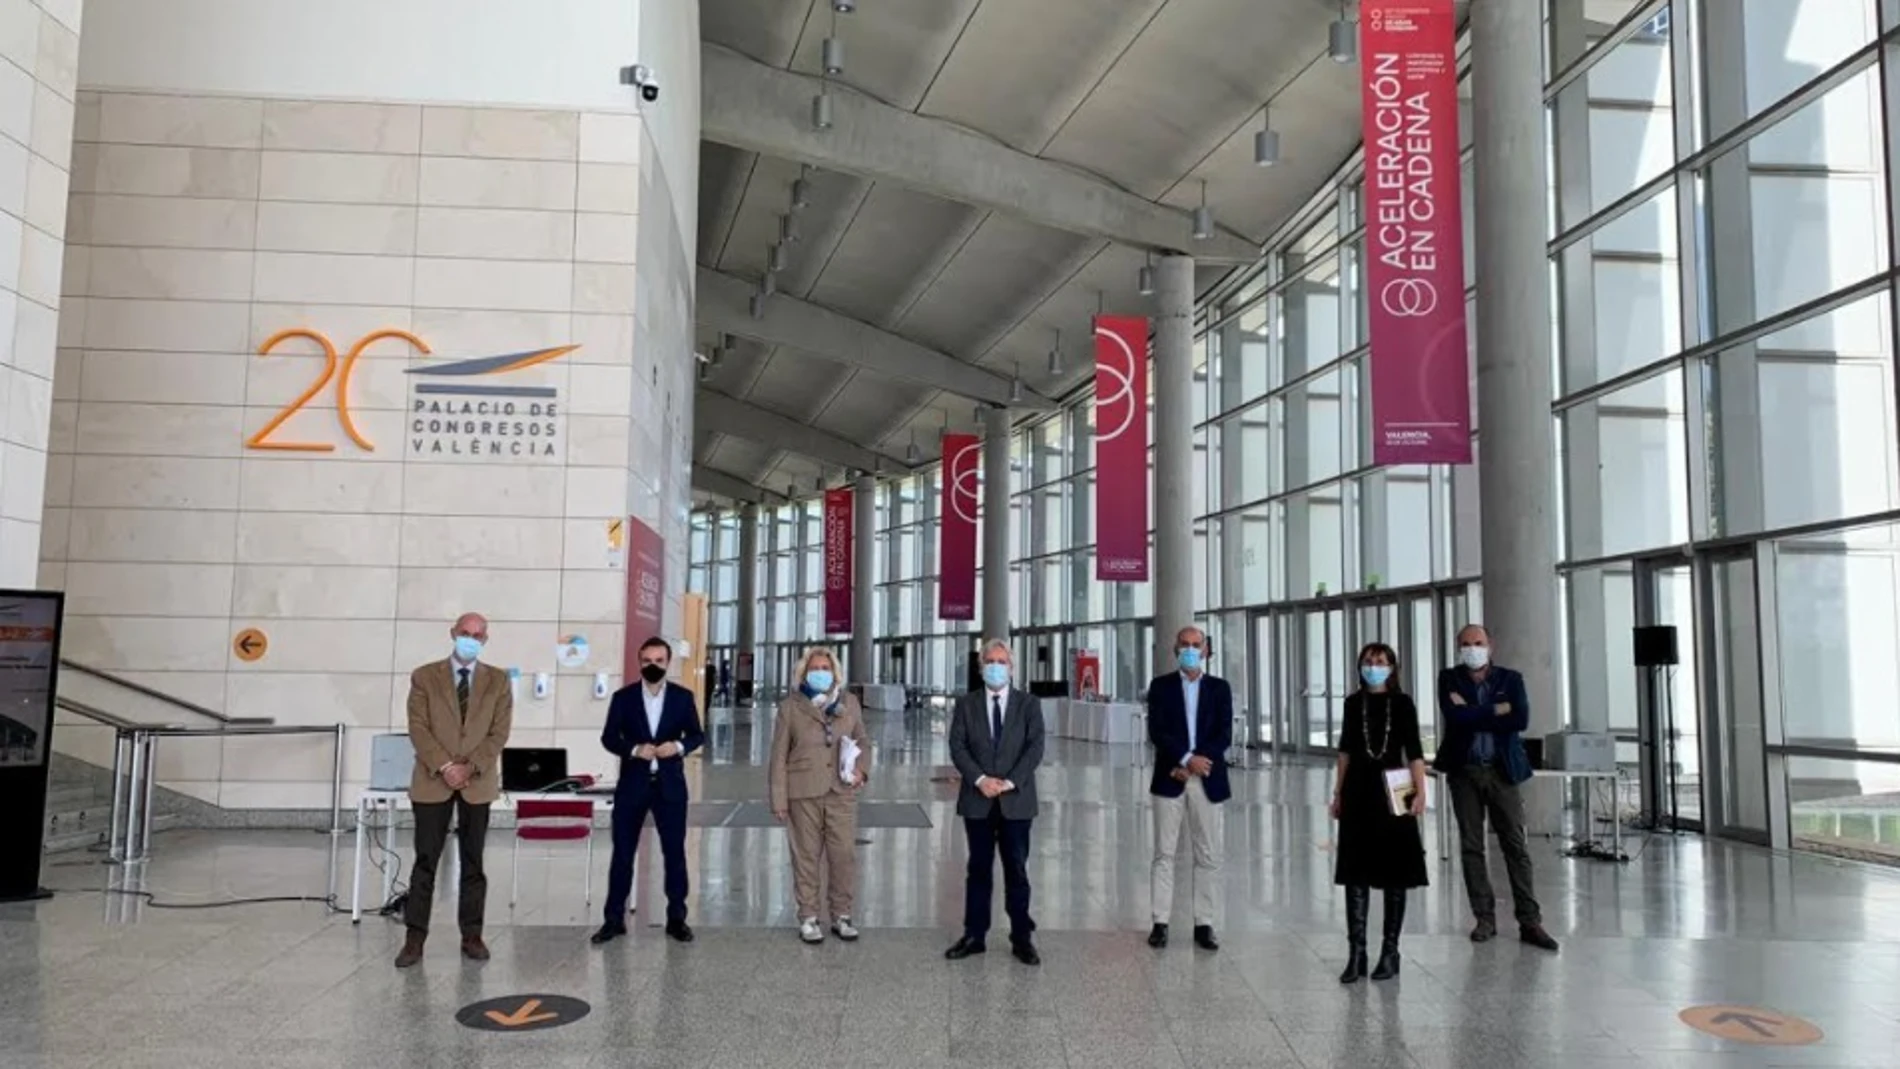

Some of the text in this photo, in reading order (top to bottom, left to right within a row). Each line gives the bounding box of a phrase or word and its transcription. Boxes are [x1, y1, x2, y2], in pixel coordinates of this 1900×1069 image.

[1370, 52, 1407, 269] ACELERACIÓN
[1405, 91, 1435, 222] CADENA
[1411, 230, 1436, 271] EN
[412, 419, 557, 437] CONGRESOS
[413, 399, 557, 418] PALACIO DE
